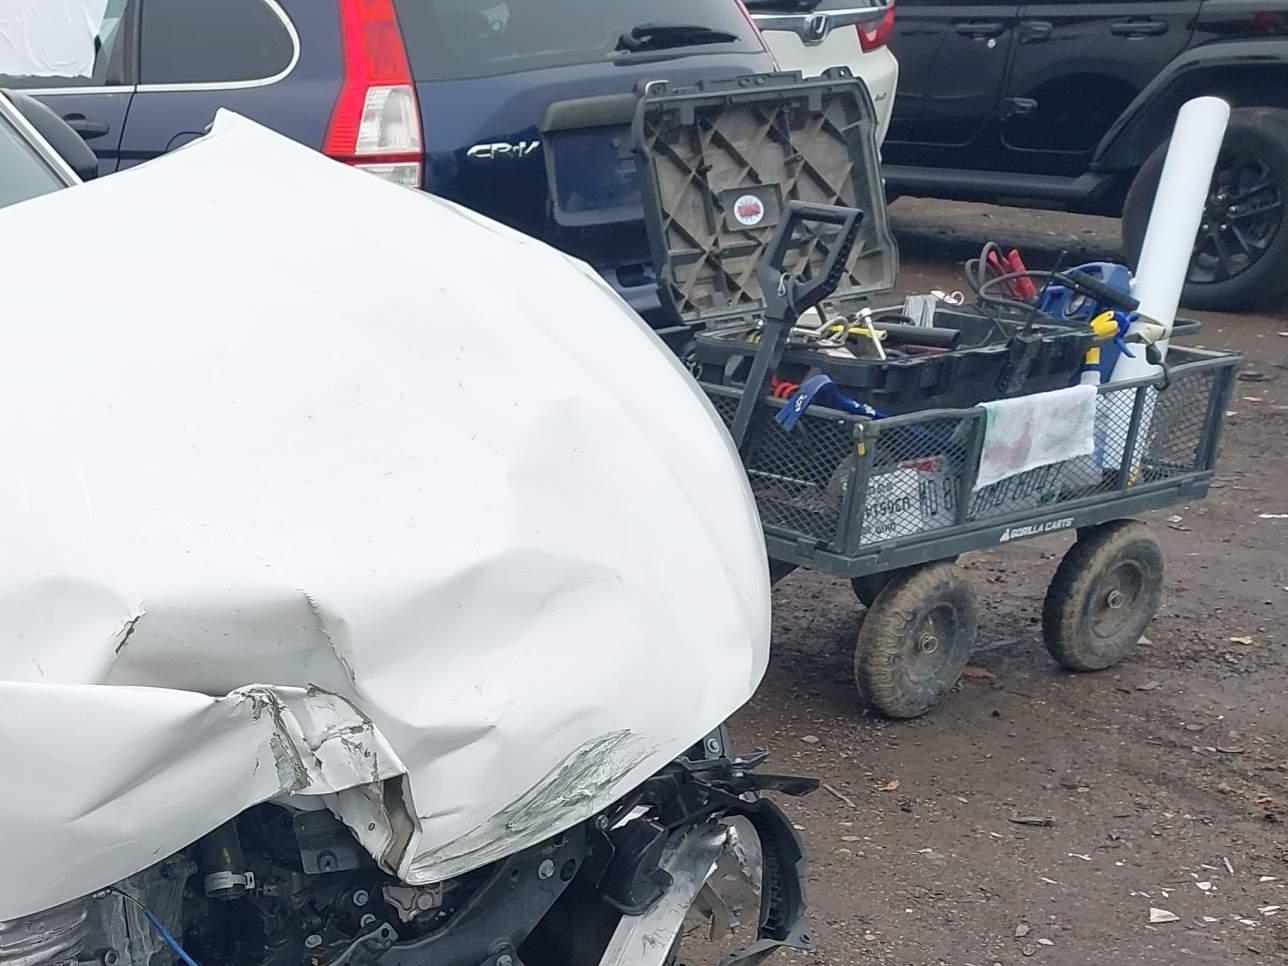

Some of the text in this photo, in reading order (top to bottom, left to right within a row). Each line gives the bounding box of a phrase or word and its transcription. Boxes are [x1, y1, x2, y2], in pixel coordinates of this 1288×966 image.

[466, 141, 540, 159] CR-V
[1010, 517, 1074, 539] GORILLA CARTS
